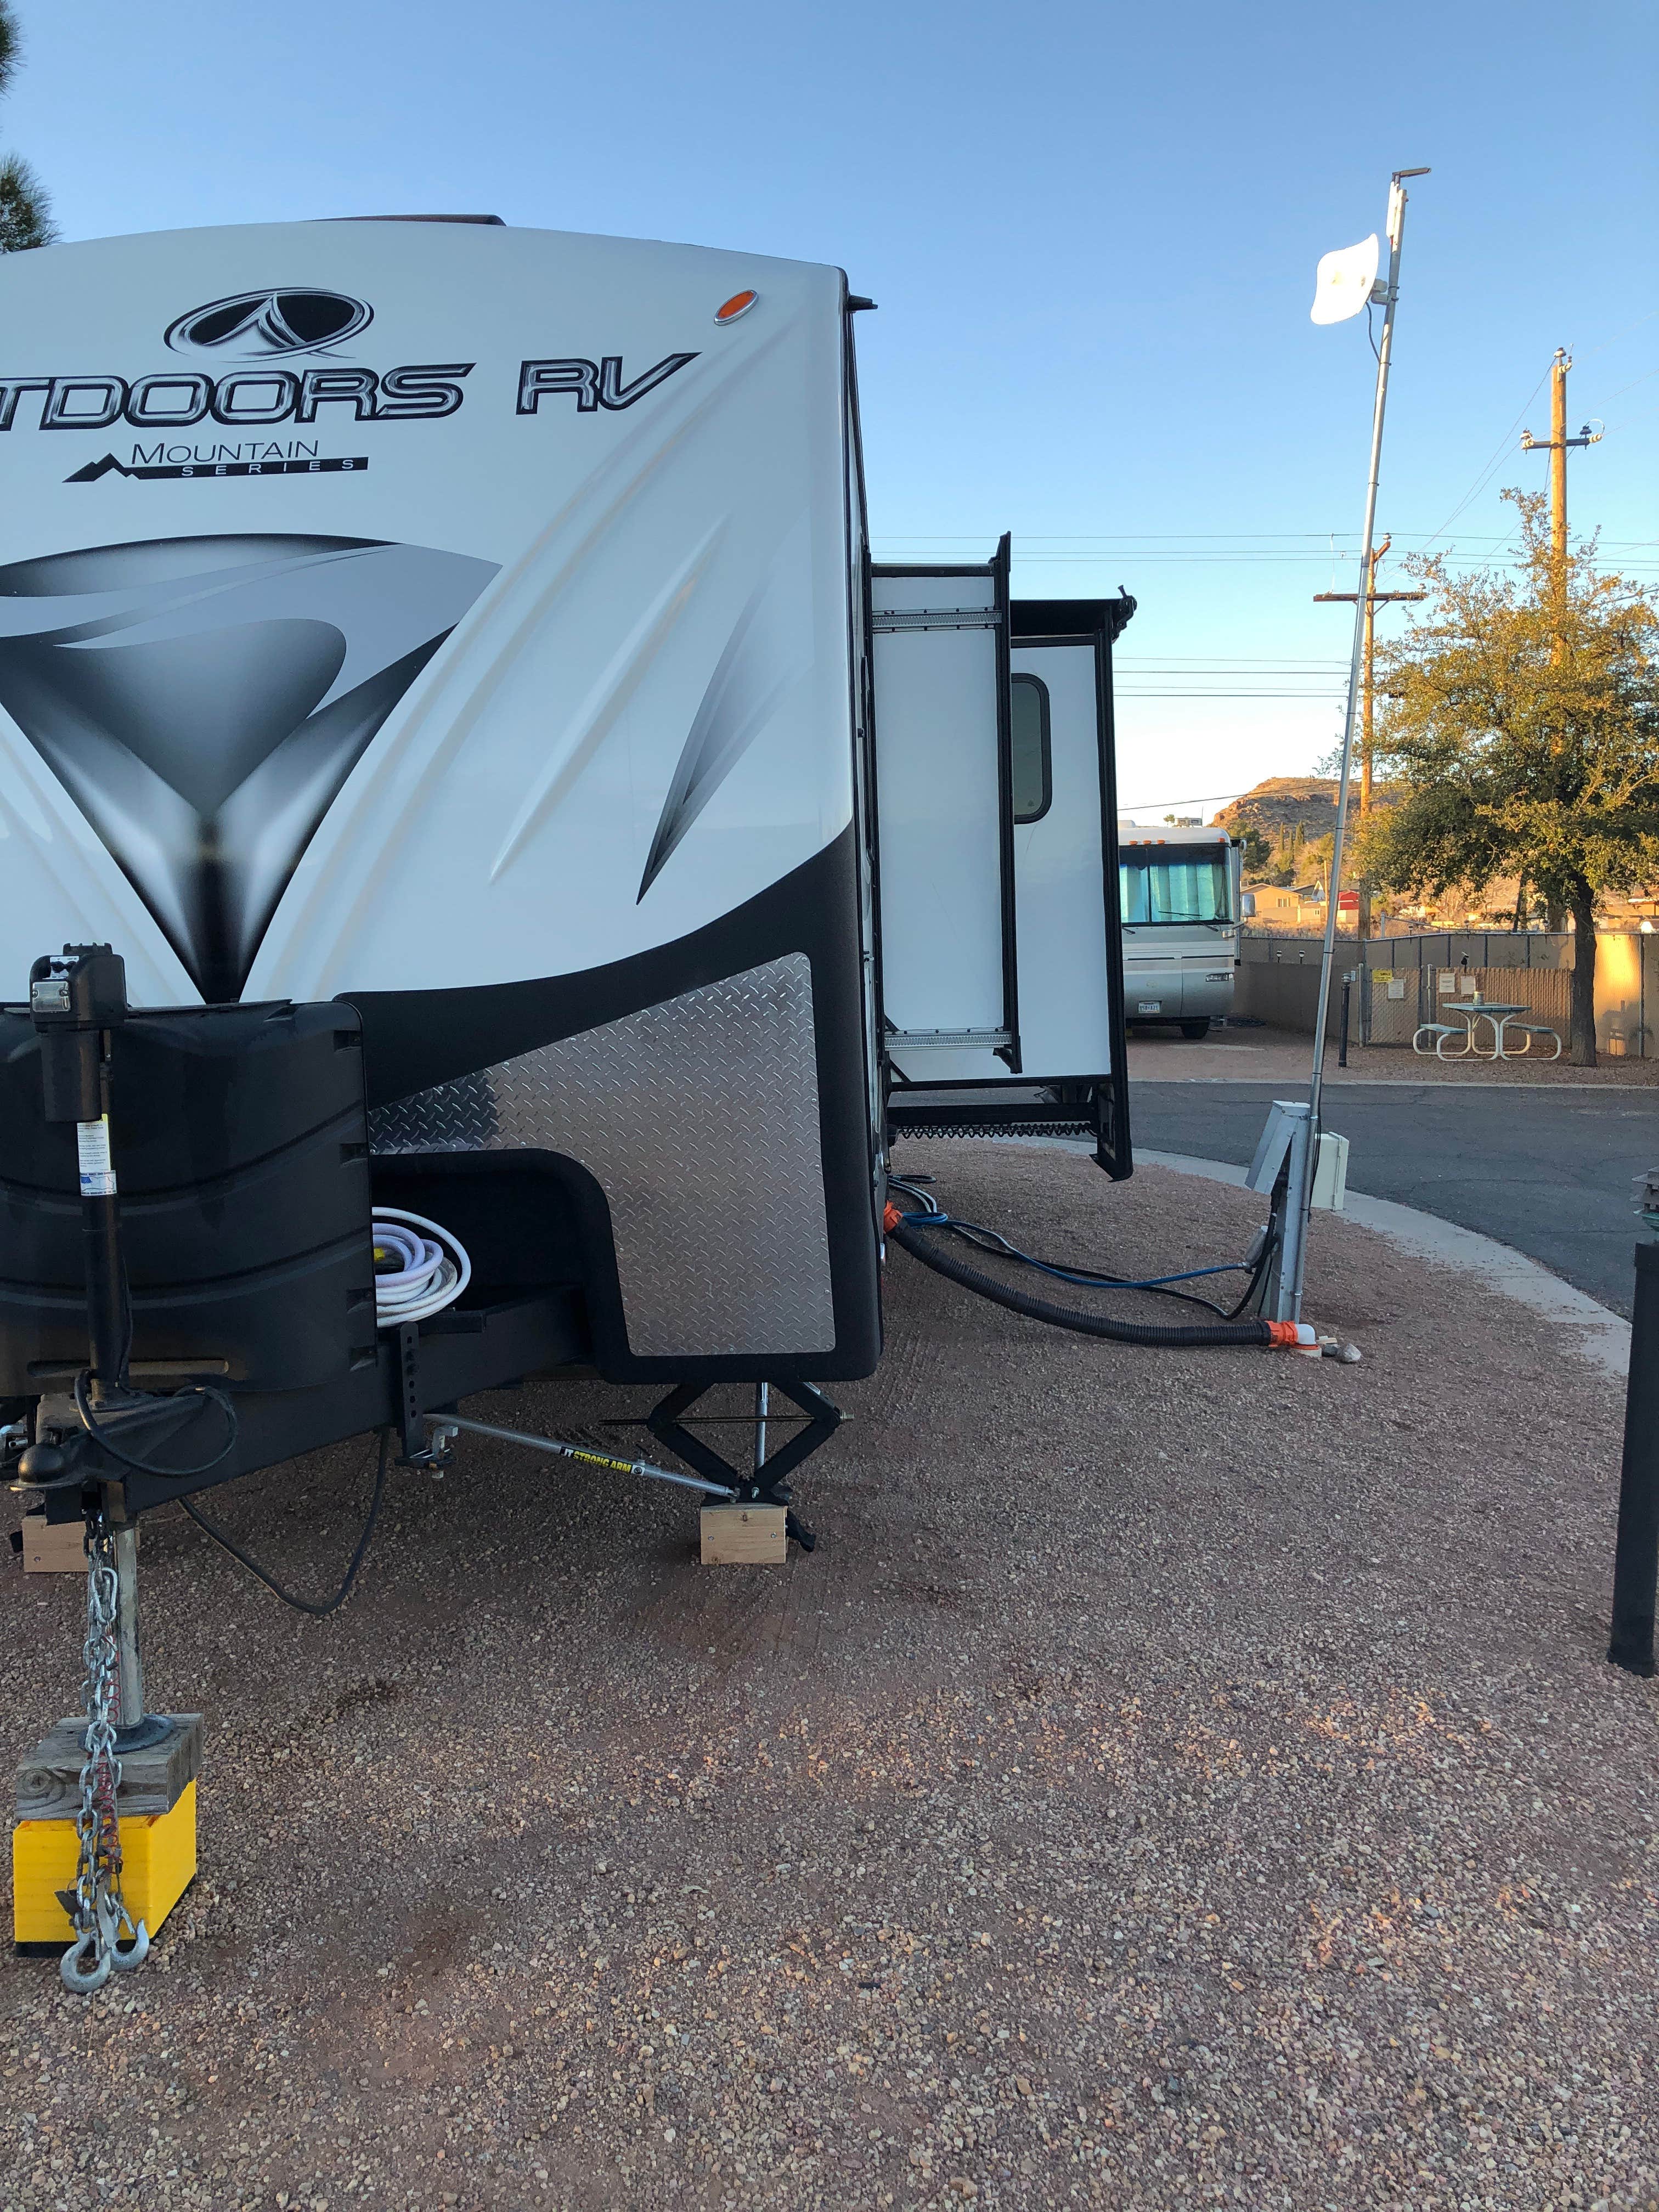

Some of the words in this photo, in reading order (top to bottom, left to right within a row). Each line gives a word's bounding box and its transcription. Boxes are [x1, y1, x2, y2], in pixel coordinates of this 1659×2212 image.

[516, 352, 703, 415] RV
[131, 440, 319, 464] MOUNTAIN
[182, 459, 354, 476] SERIES
[573, 1451, 610, 1468] STRONG
[610, 1460, 631, 1472] ARM
